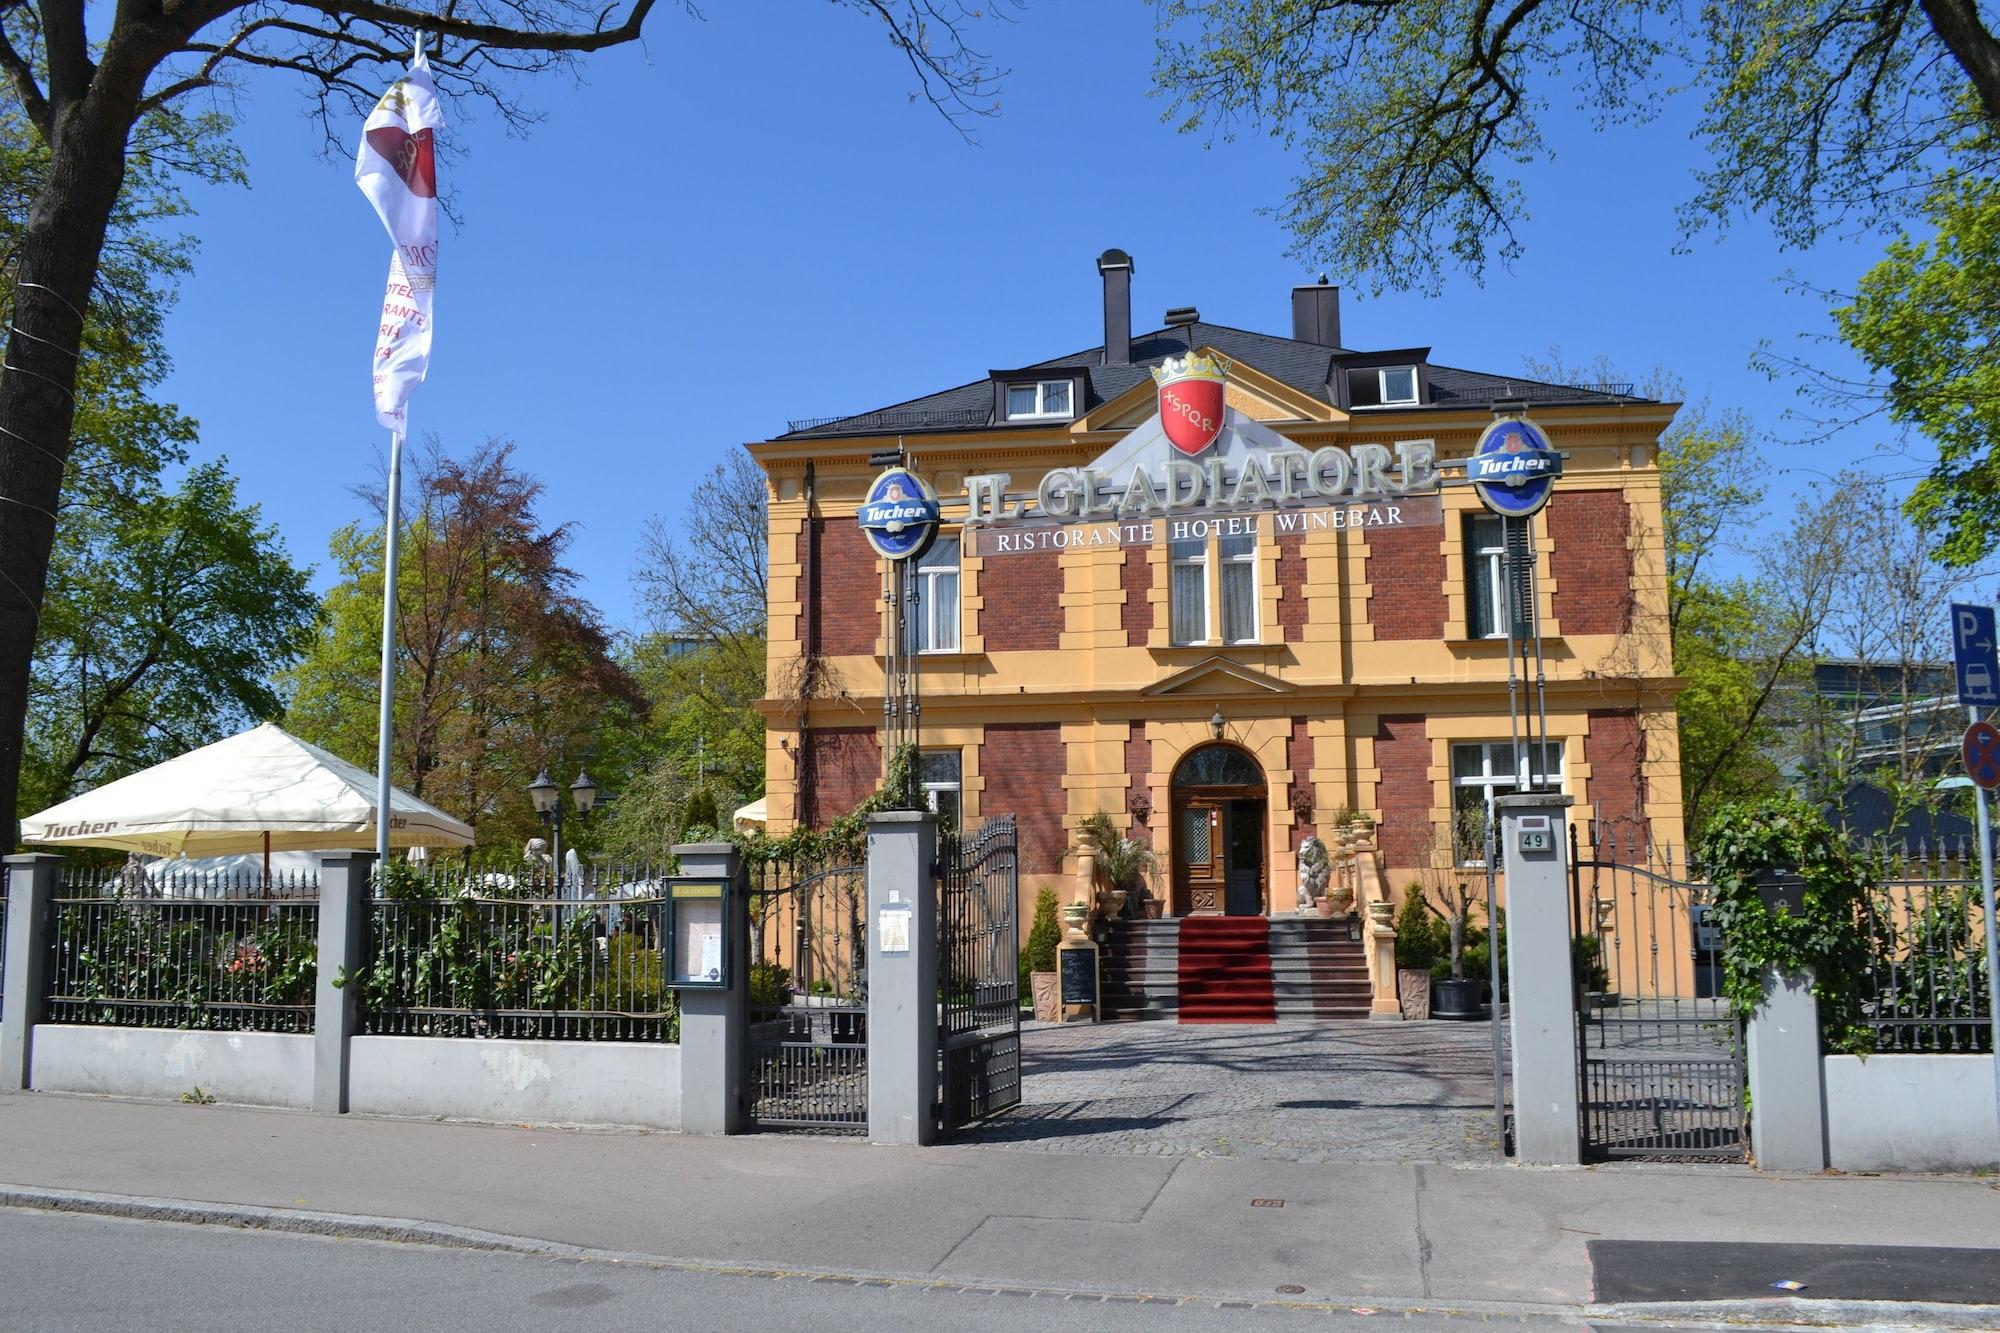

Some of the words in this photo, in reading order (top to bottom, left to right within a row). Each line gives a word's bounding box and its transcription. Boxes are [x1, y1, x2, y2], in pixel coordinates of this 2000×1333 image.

[1172, 397, 1215, 432] SPQR
[1479, 456, 1552, 475] Tucher
[964, 472, 1026, 525] IL
[1038, 438, 1441, 518] GLADIATORE
[867, 504, 927, 522] Tucher
[997, 523, 1155, 552] RISTORANTE
[1172, 516, 1259, 540] HOTEL
[1277, 506, 1405, 532] WINEBAR
[1958, 611, 1978, 650] P
[44, 820, 119, 839] Tucher
[390, 814, 407, 829] cher
[1524, 834, 1543, 847] 49
